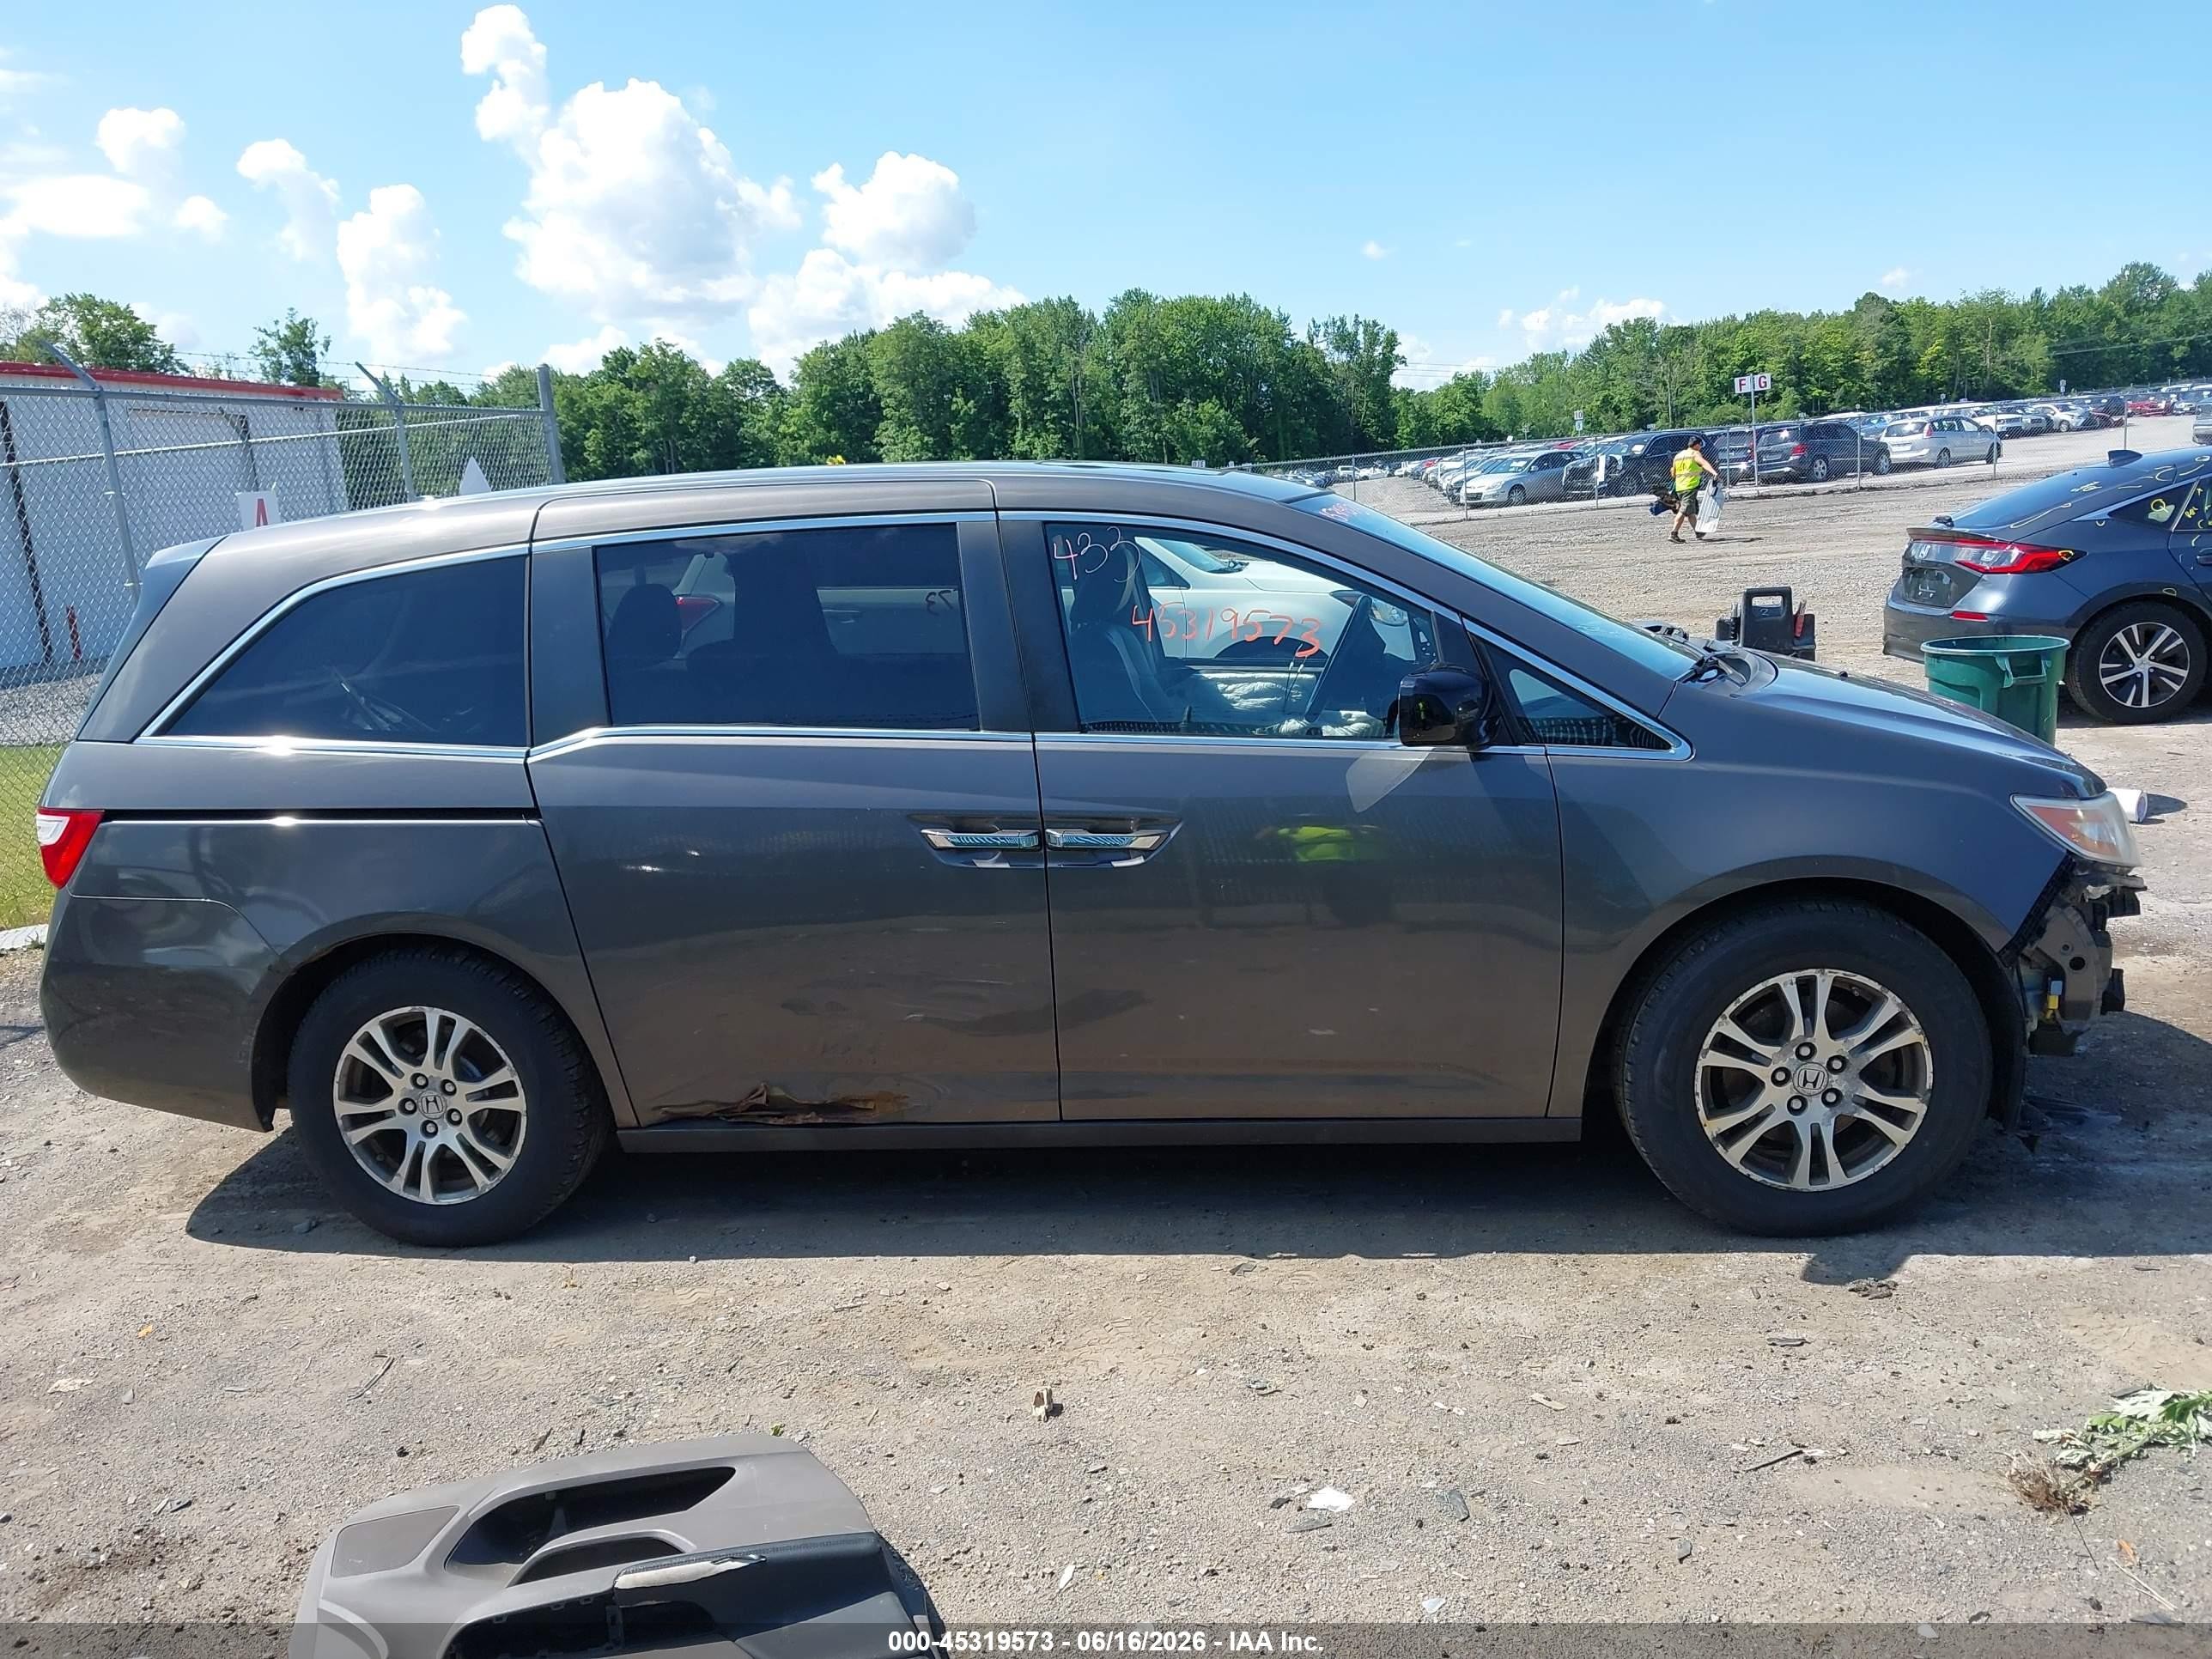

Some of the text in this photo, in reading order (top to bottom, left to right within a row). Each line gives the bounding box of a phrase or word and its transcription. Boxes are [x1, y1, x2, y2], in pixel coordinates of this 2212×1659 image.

[1739, 379, 1746, 392] F
[1759, 375, 1767, 388] G
[256, 498, 268, 527] A
[1054, 526, 1141, 583] 433
[1132, 601, 1321, 658] 45319573
